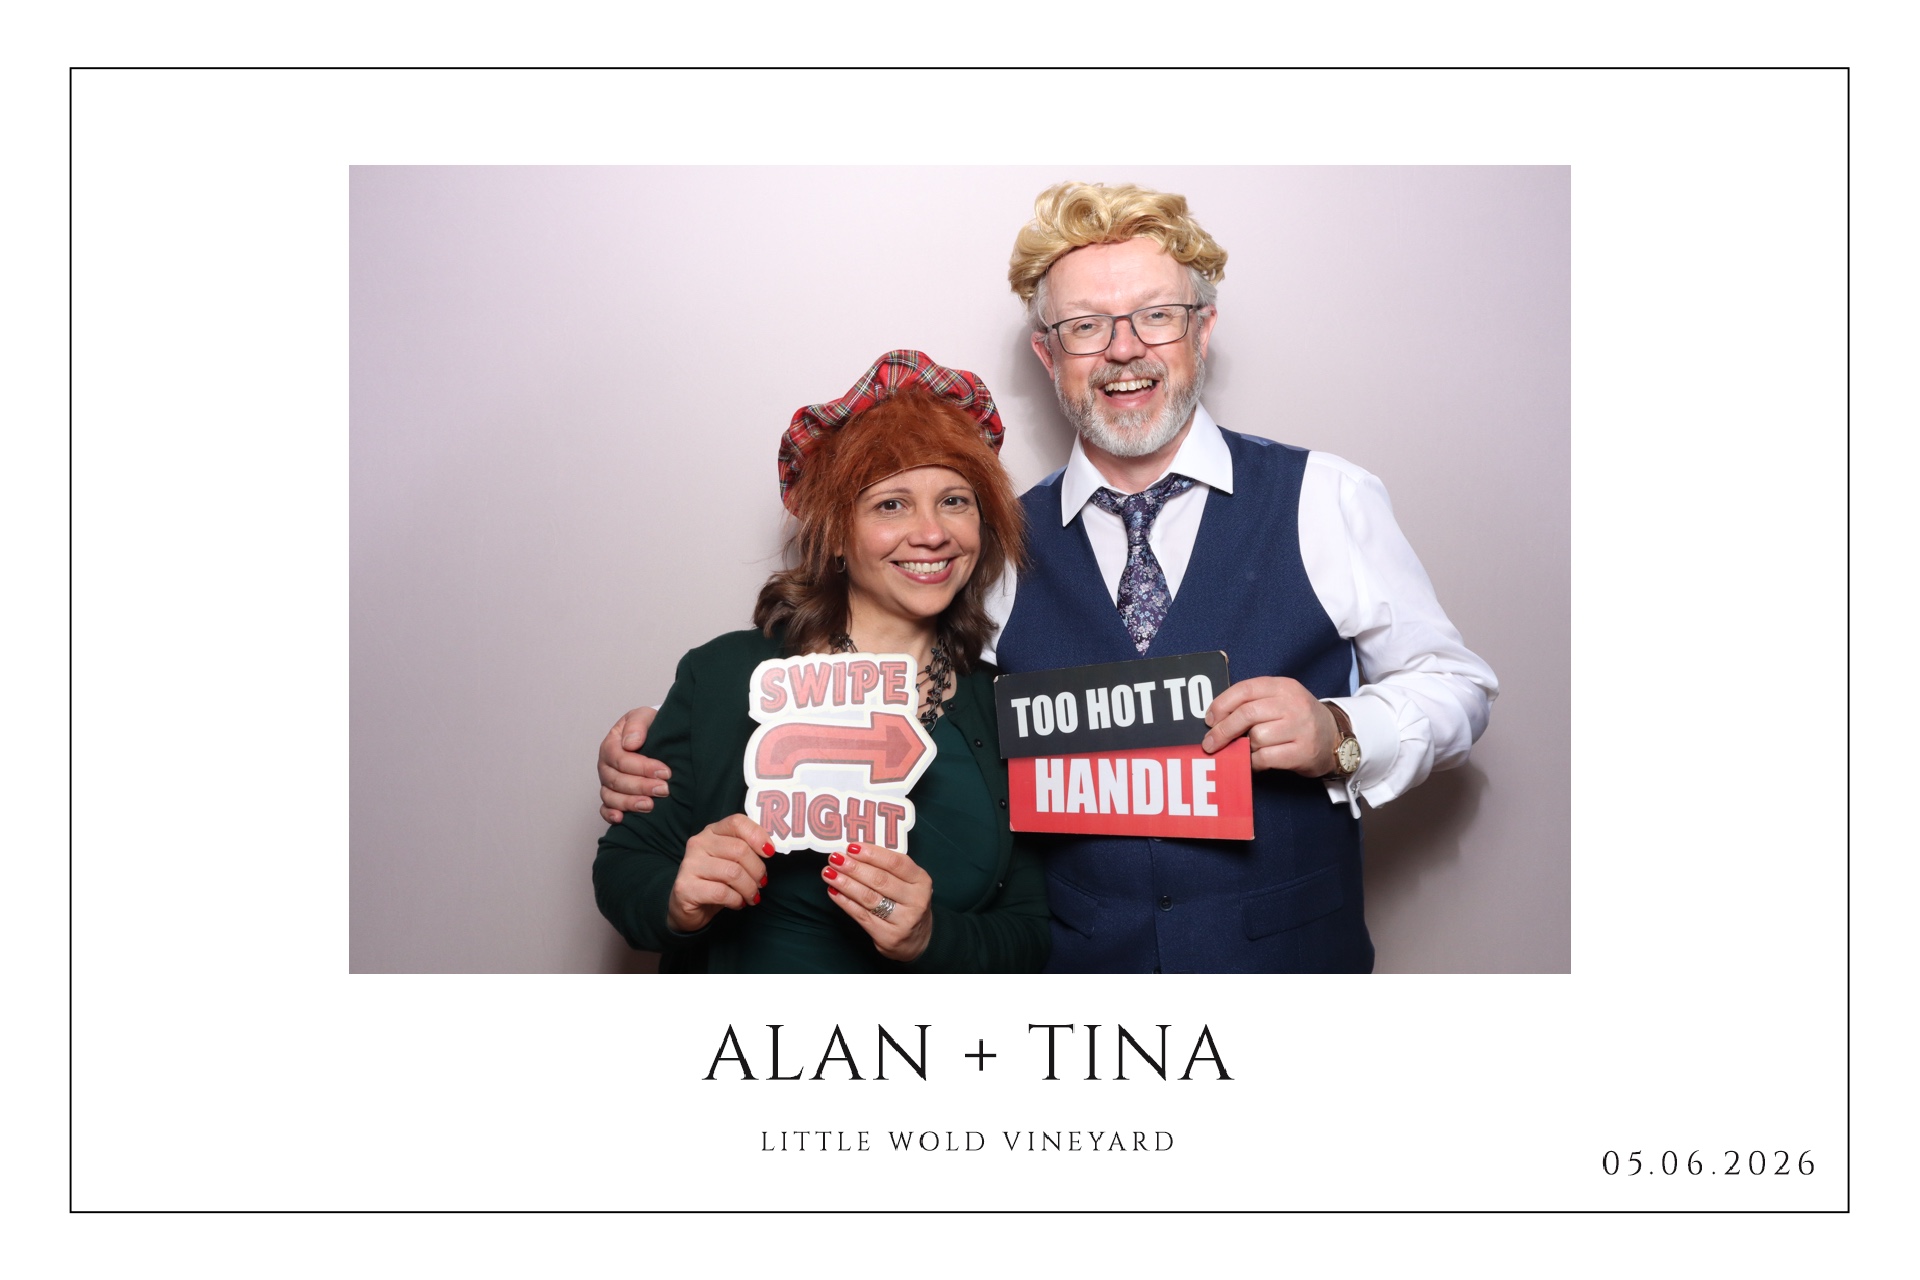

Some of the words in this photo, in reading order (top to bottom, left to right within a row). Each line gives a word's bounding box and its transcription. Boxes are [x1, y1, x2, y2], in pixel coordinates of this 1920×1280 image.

[760, 660, 909, 713] SWIPE
[1010, 691, 1079, 738] TOO
[1085, 681, 1156, 730] HOT
[1163, 674, 1214, 721] TO
[1034, 758, 1219, 817] HANDLE
[756, 789, 906, 849] RIGHT
